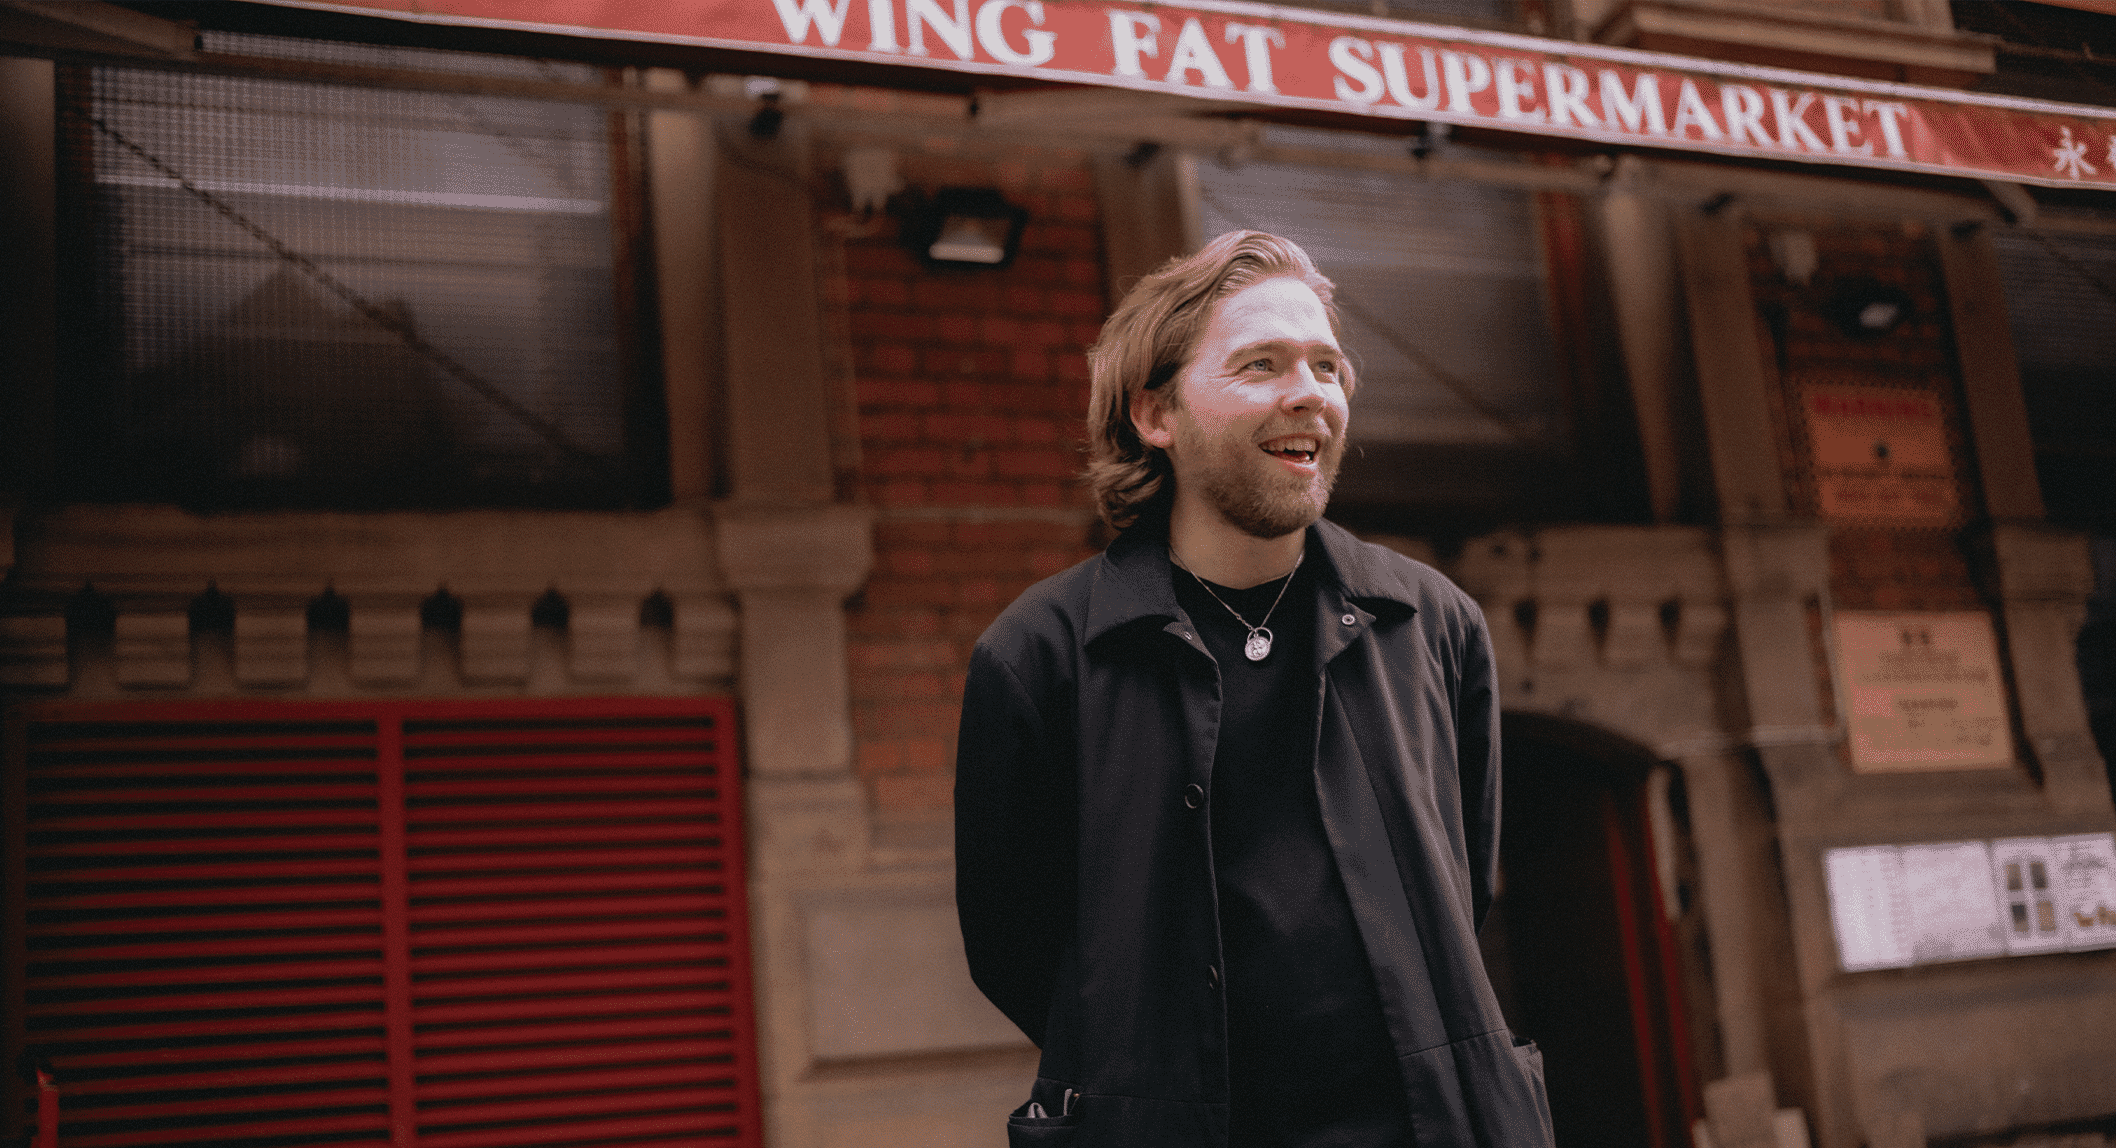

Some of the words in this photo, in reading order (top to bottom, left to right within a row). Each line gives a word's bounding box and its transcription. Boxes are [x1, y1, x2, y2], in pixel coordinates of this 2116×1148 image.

[772, 0, 1057, 67] WING
[1109, 11, 1286, 94] FAT
[1328, 37, 1908, 160] SUPERMARKET
[2051, 125, 2116, 181] 永
